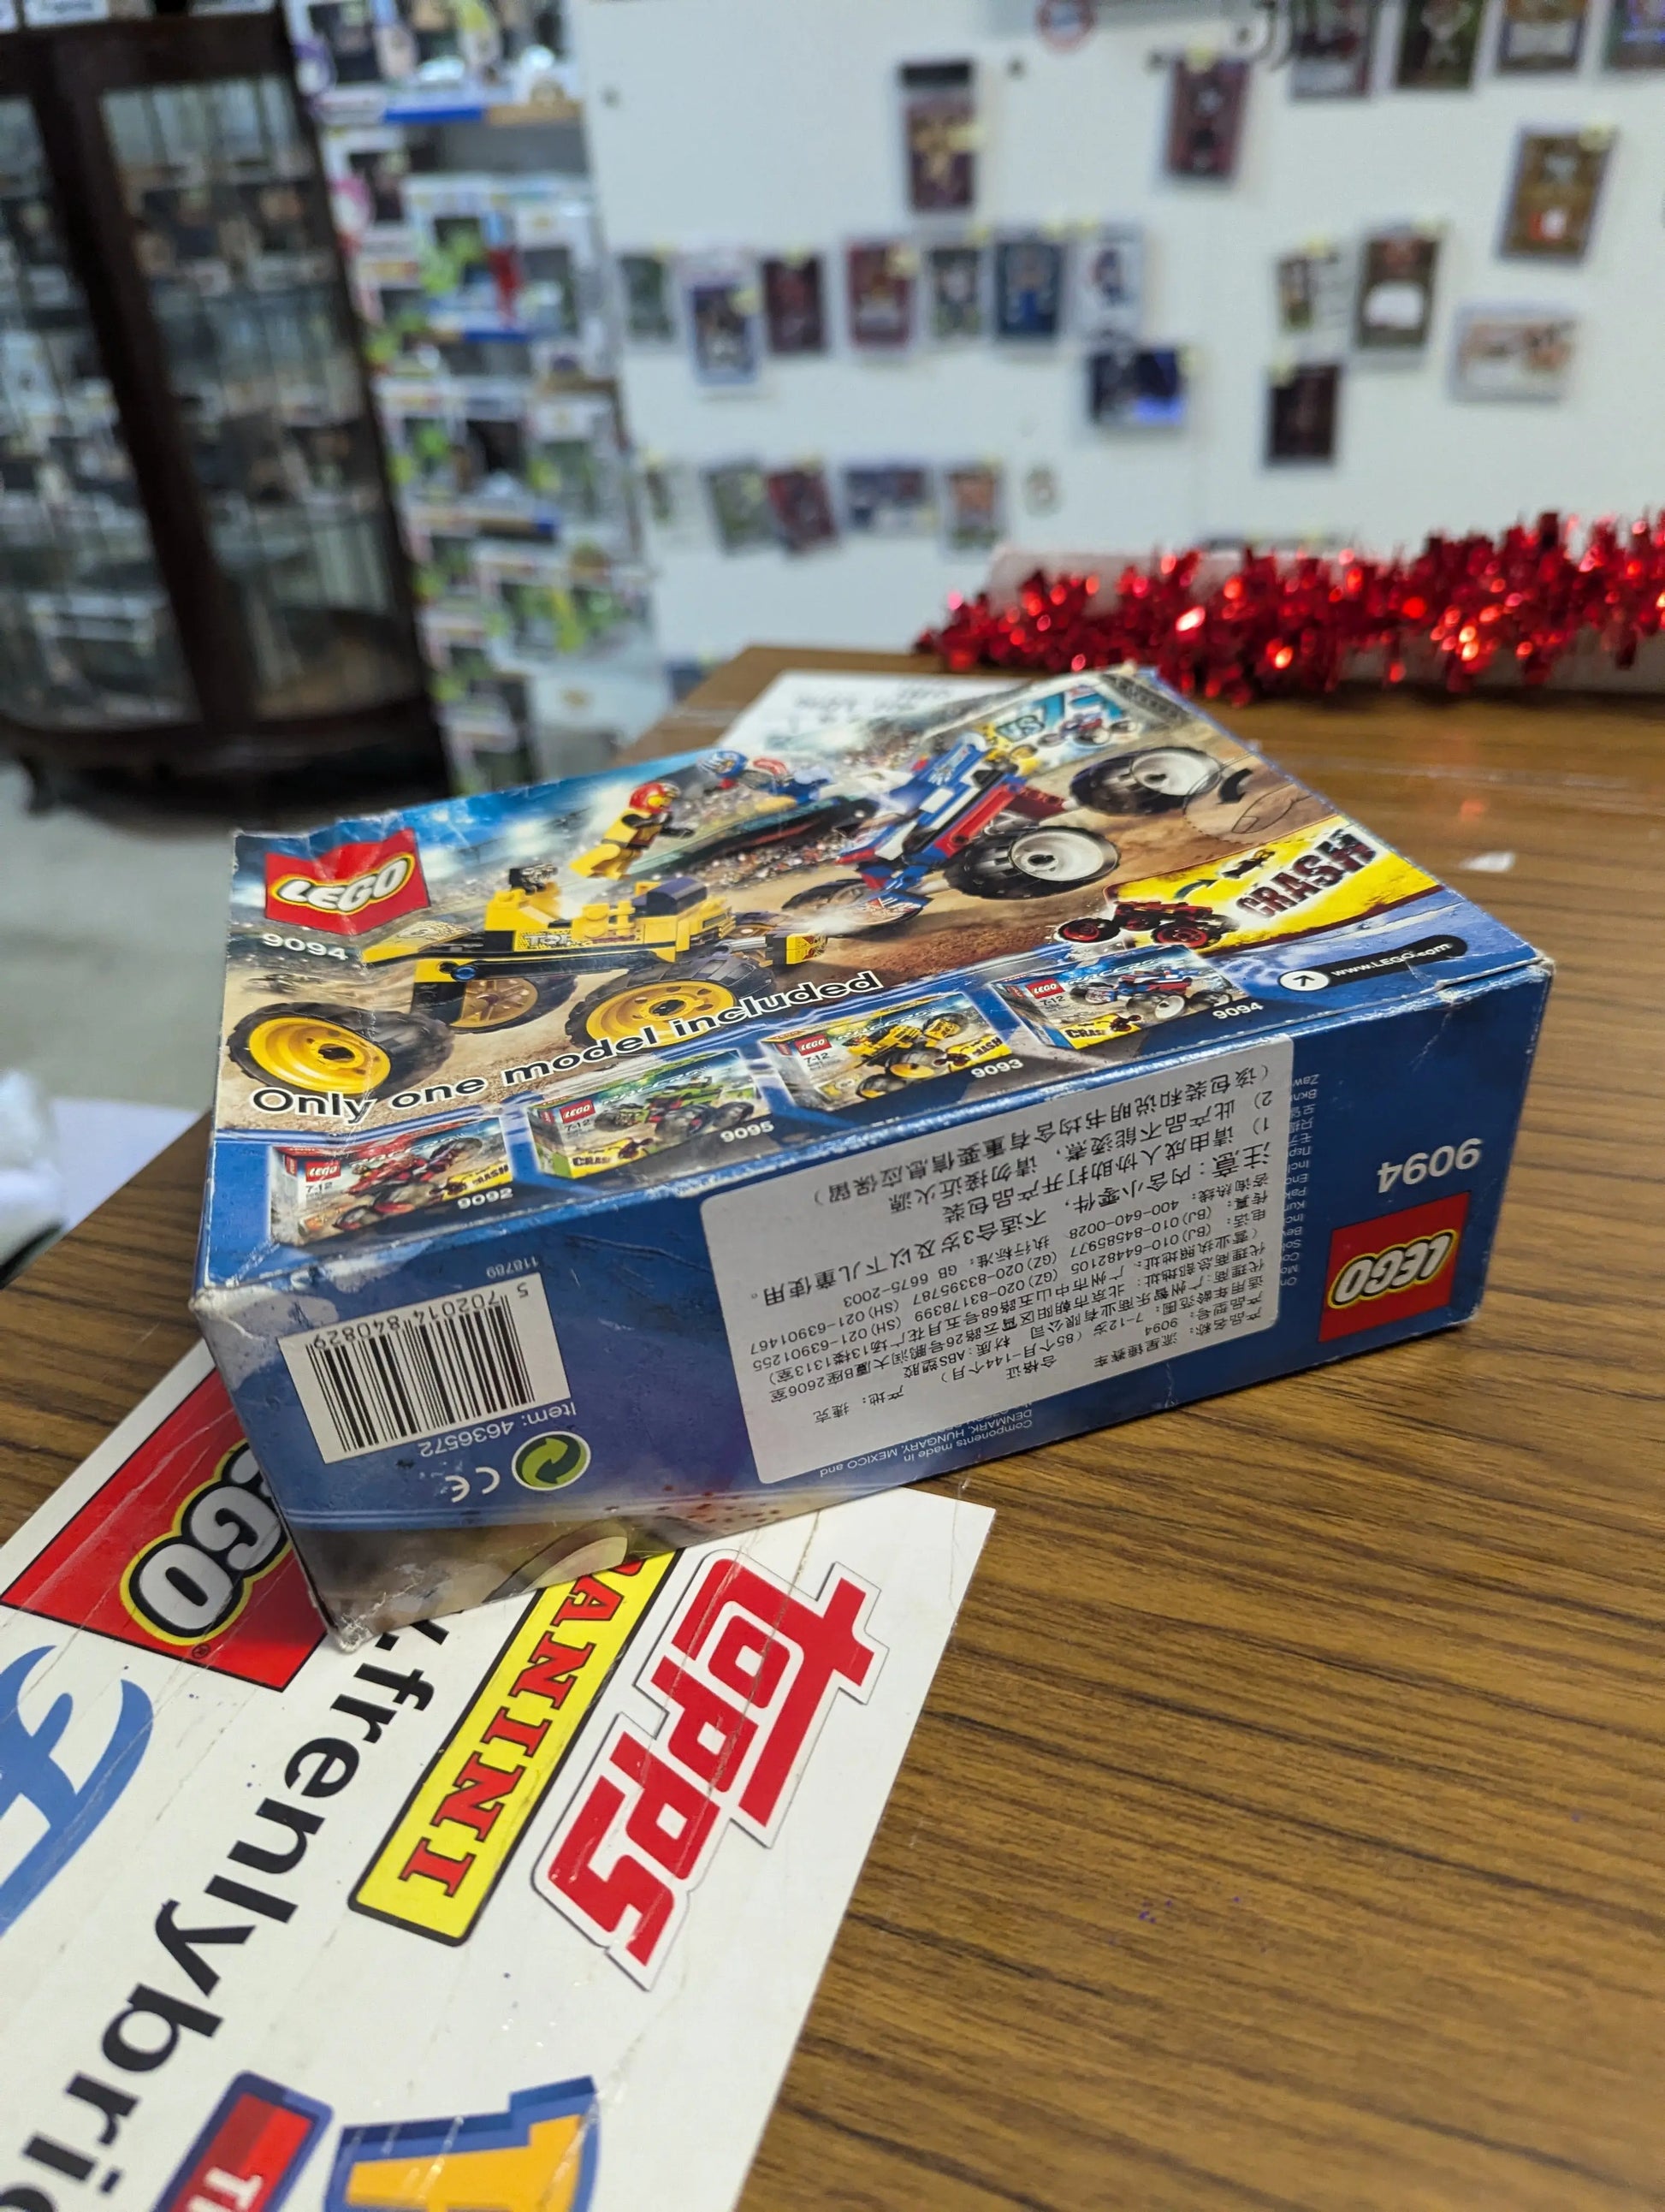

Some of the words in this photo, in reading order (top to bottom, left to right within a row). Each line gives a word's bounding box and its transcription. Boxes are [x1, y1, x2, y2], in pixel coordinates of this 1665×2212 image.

[274, 855, 412, 913] LEGO
[1236, 829, 1376, 918] CRASH
[262, 933, 349, 960] 9094
[1330, 943, 1453, 976] www.LEGO.com
[1033, 983, 1058, 993] LEGO
[1040, 995, 1066, 1005] 7-12
[1212, 1002, 1264, 1020] 9094
[254, 1088, 375, 1124] Only
[391, 1077, 485, 1109] one
[503, 1025, 656, 1085] model
[674, 971, 883, 1037] included
[800, 1039, 826, 1051] LEGO
[804, 1053, 830, 1064] 7-12
[971, 1059, 1023, 1078] 9093
[564, 1104, 591, 1118] LEGO
[720, 1121, 774, 1142] 9095
[309, 1165, 338, 1177] LEGO
[1377, 1137, 1484, 1194] 9094
[457, 1188, 513, 1209] 9092
[486, 1256, 538, 1278] 118789
[1331, 1232, 1455, 1306] LEGO
[517, 1282, 530, 1299] 5
[841, 1271, 928, 1308] 6675-2003
[413, 1290, 500, 1324] 702014
[313, 1314, 403, 1349] 840829
[1004, 1351, 1058, 1381] 合格证
[522, 1401, 577, 1426] Item:
[418, 1420, 515, 1458] 4636572
[956, 1419, 1034, 1446] Components
[847, 1447, 898, 1469] MEXICO
[904, 1449, 915, 1462] in
[918, 1441, 953, 1458] made
[819, 1463, 844, 1479] and
[128, 1443, 285, 1638] GO
[397, 1560, 646, 1897] ANINI
